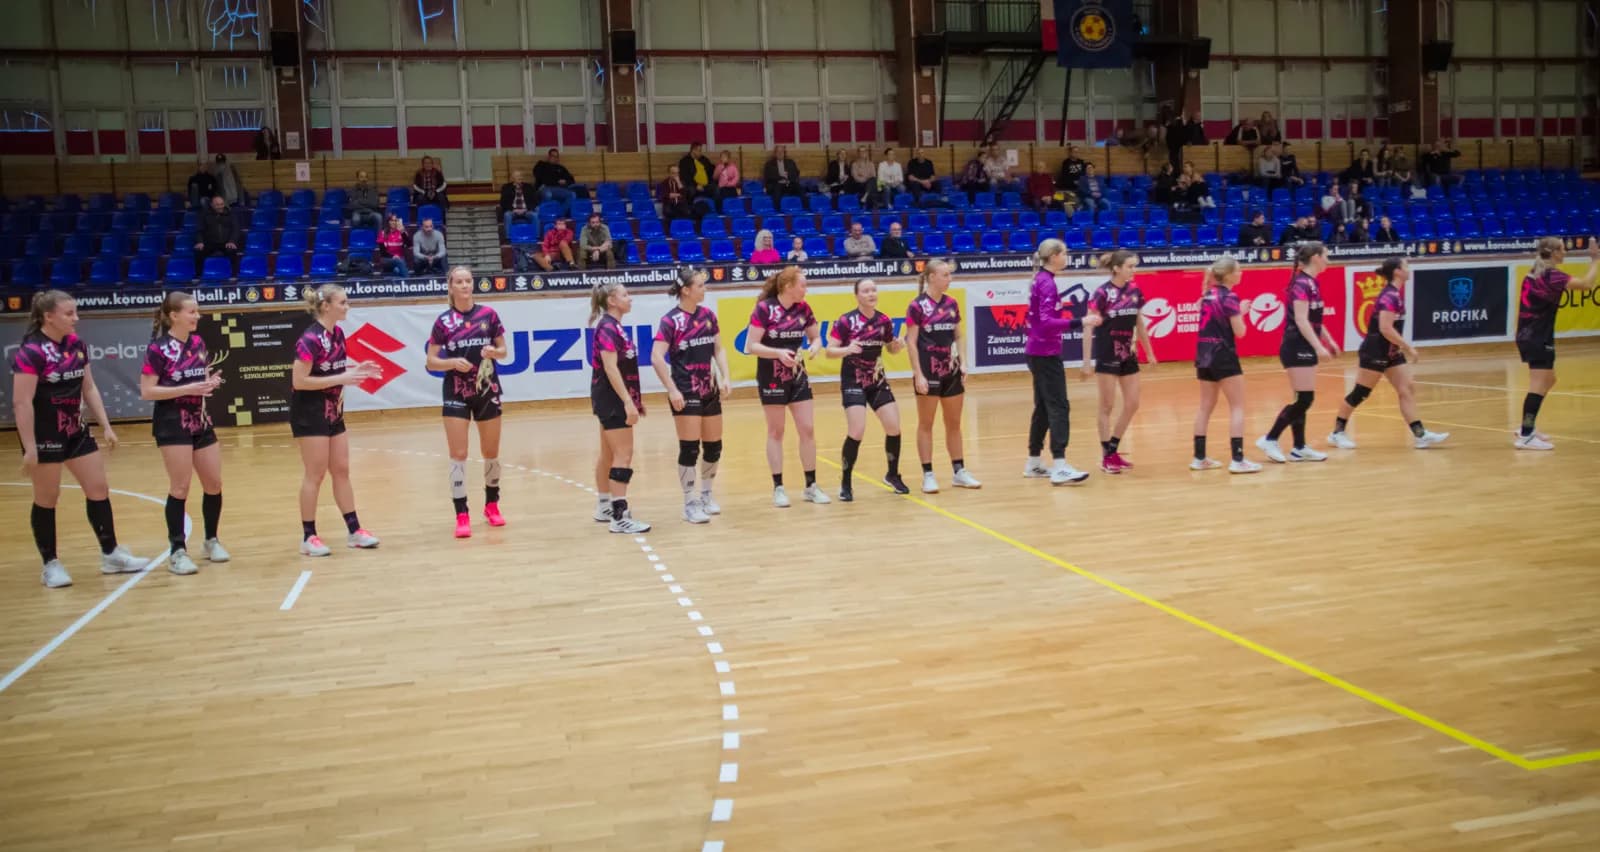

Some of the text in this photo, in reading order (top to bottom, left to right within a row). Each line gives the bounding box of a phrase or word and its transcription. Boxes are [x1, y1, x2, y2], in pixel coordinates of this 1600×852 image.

[1432, 308, 1489, 323] PROFIKA
[987, 335, 1021, 344] Zawsze
[239, 364, 269, 372] CENTRUM
